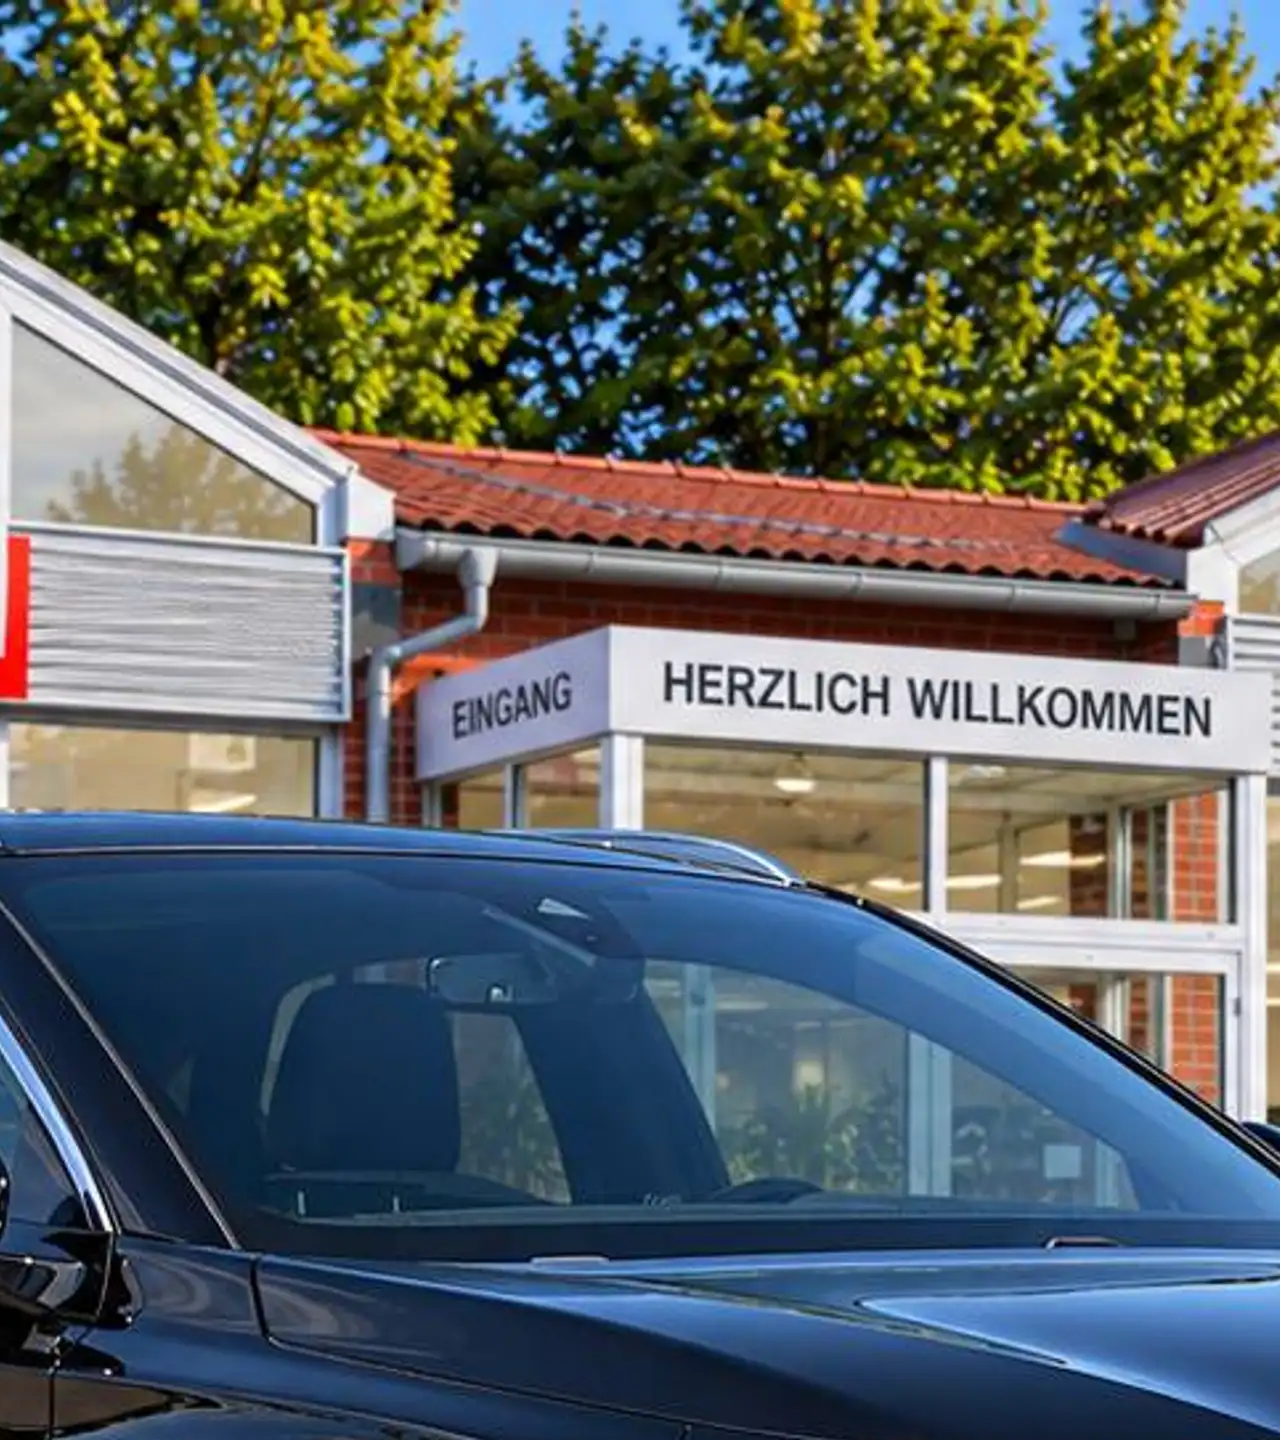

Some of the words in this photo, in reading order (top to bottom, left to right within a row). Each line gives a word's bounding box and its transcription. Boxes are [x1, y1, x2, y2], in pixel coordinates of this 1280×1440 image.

[453, 670, 572, 739] EINGANG
[662, 661, 890, 717] HERZLICH
[907, 678, 1214, 738] WILLKOMMEN
